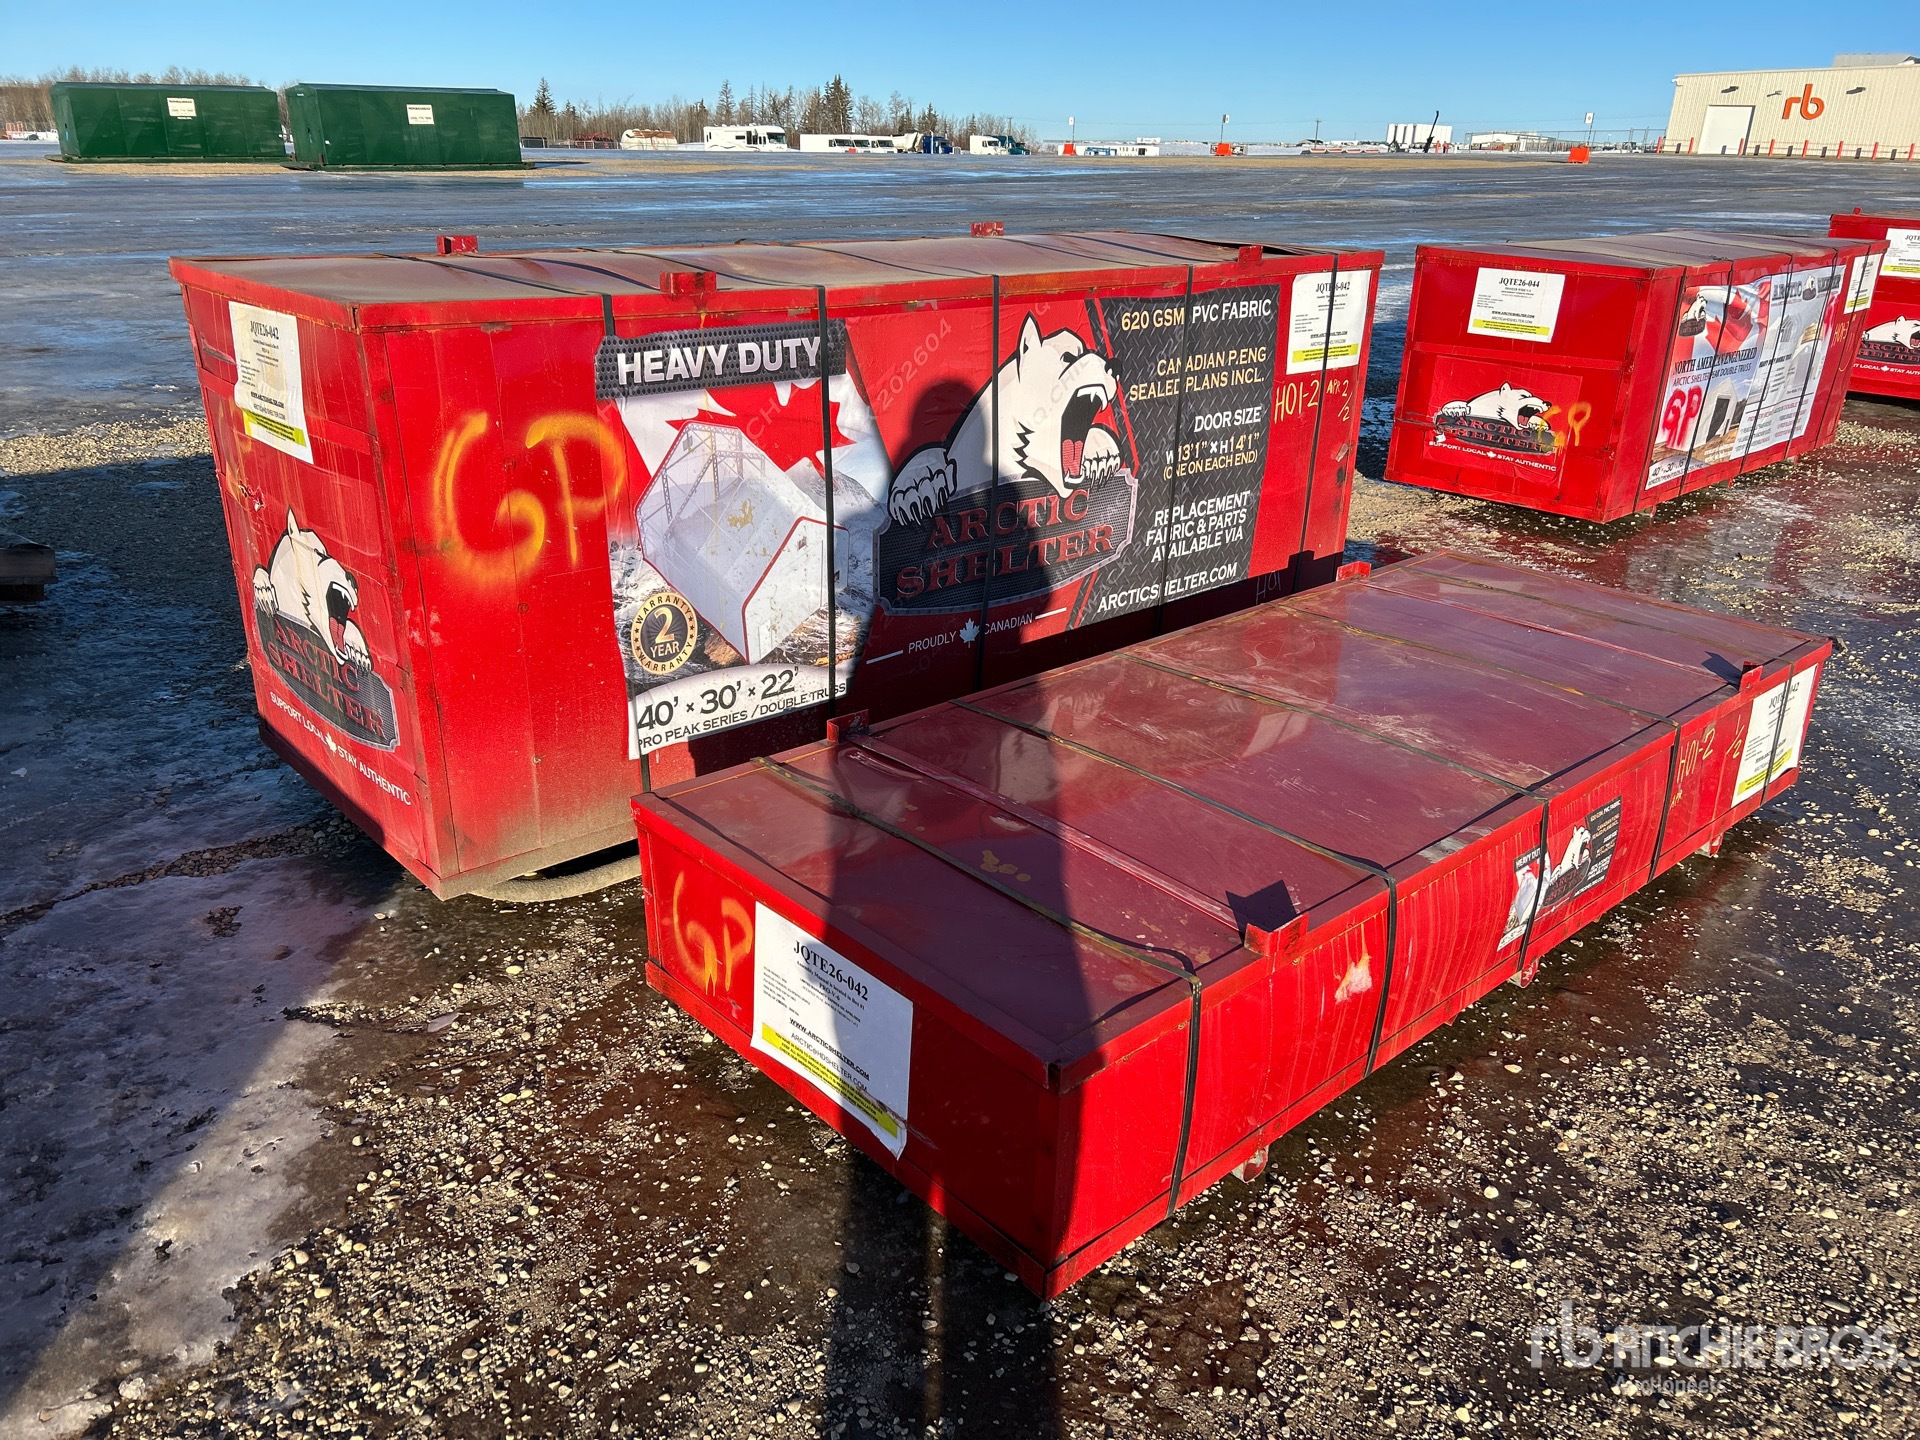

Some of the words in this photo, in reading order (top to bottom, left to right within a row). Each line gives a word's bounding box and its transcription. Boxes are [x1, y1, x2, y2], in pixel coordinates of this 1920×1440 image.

[1782, 84, 1825, 120] rb
[1498, 277, 1540, 288] JQTE26-044
[1121, 310, 1149, 331] 620
[1153, 307, 1185, 328] GSM
[1192, 304, 1219, 324] PVC
[1221, 298, 1272, 320] FABRIC
[617, 343, 729, 385] HEAVY
[737, 336, 821, 374] DUTY
[1157, 350, 1226, 376] CANADIAN
[1228, 346, 1267, 368] P.ENG
[1185, 371, 1229, 393] PLANS
[1231, 367, 1265, 388] INCL.
[1194, 410, 1232, 433] DOOR
[1233, 406, 1262, 425] SIZE
[1456, 417, 1532, 438] ARCTIC
[1188, 458, 1203, 475] ON
[1204, 453, 1234, 472] EACH
[1234, 449, 1258, 469] END)
[1428, 441, 1461, 452] SUPPORT
[1462, 446, 1487, 456] LOCAL
[1497, 453, 1514, 462] STAY
[1515, 458, 1557, 472] AUTHENTIC
[926, 489, 1090, 550] ARCTIC
[1154, 490, 1251, 527] REPLACEMENT
[1197, 519, 1206, 535] &
[1208, 509, 1247, 531] PARTS
[1224, 527, 1243, 545] VIA
[896, 524, 1114, 600] SHELTER
[636, 594, 693, 625] WARRANTY
[653, 606, 675, 645] 2
[273, 618, 360, 692] ARCTIC
[638, 640, 693, 672] WARRANTY
[650, 640, 680, 659] YEAR
[908, 631, 957, 654] PROUDLY
[268, 640, 387, 740] SHELTER
[638, 733, 663, 749] PRO
[665, 724, 701, 743] PEAK
[703, 710, 748, 732] SERIES
[808, 683, 846, 703] TRUSS
[269, 690, 302, 725] SUPPORT
[303, 713, 329, 746] LOCAL
[336, 744, 359, 769] STAY
[359, 762, 412, 806] AUTHENTIC
[794, 940, 868, 1001] JQTE26-042
[789, 1017, 870, 1081] WWW.ARCTICSHELTER.COM
[790, 1032, 868, 1092] ARCTIC@HDSHELTER.COM
